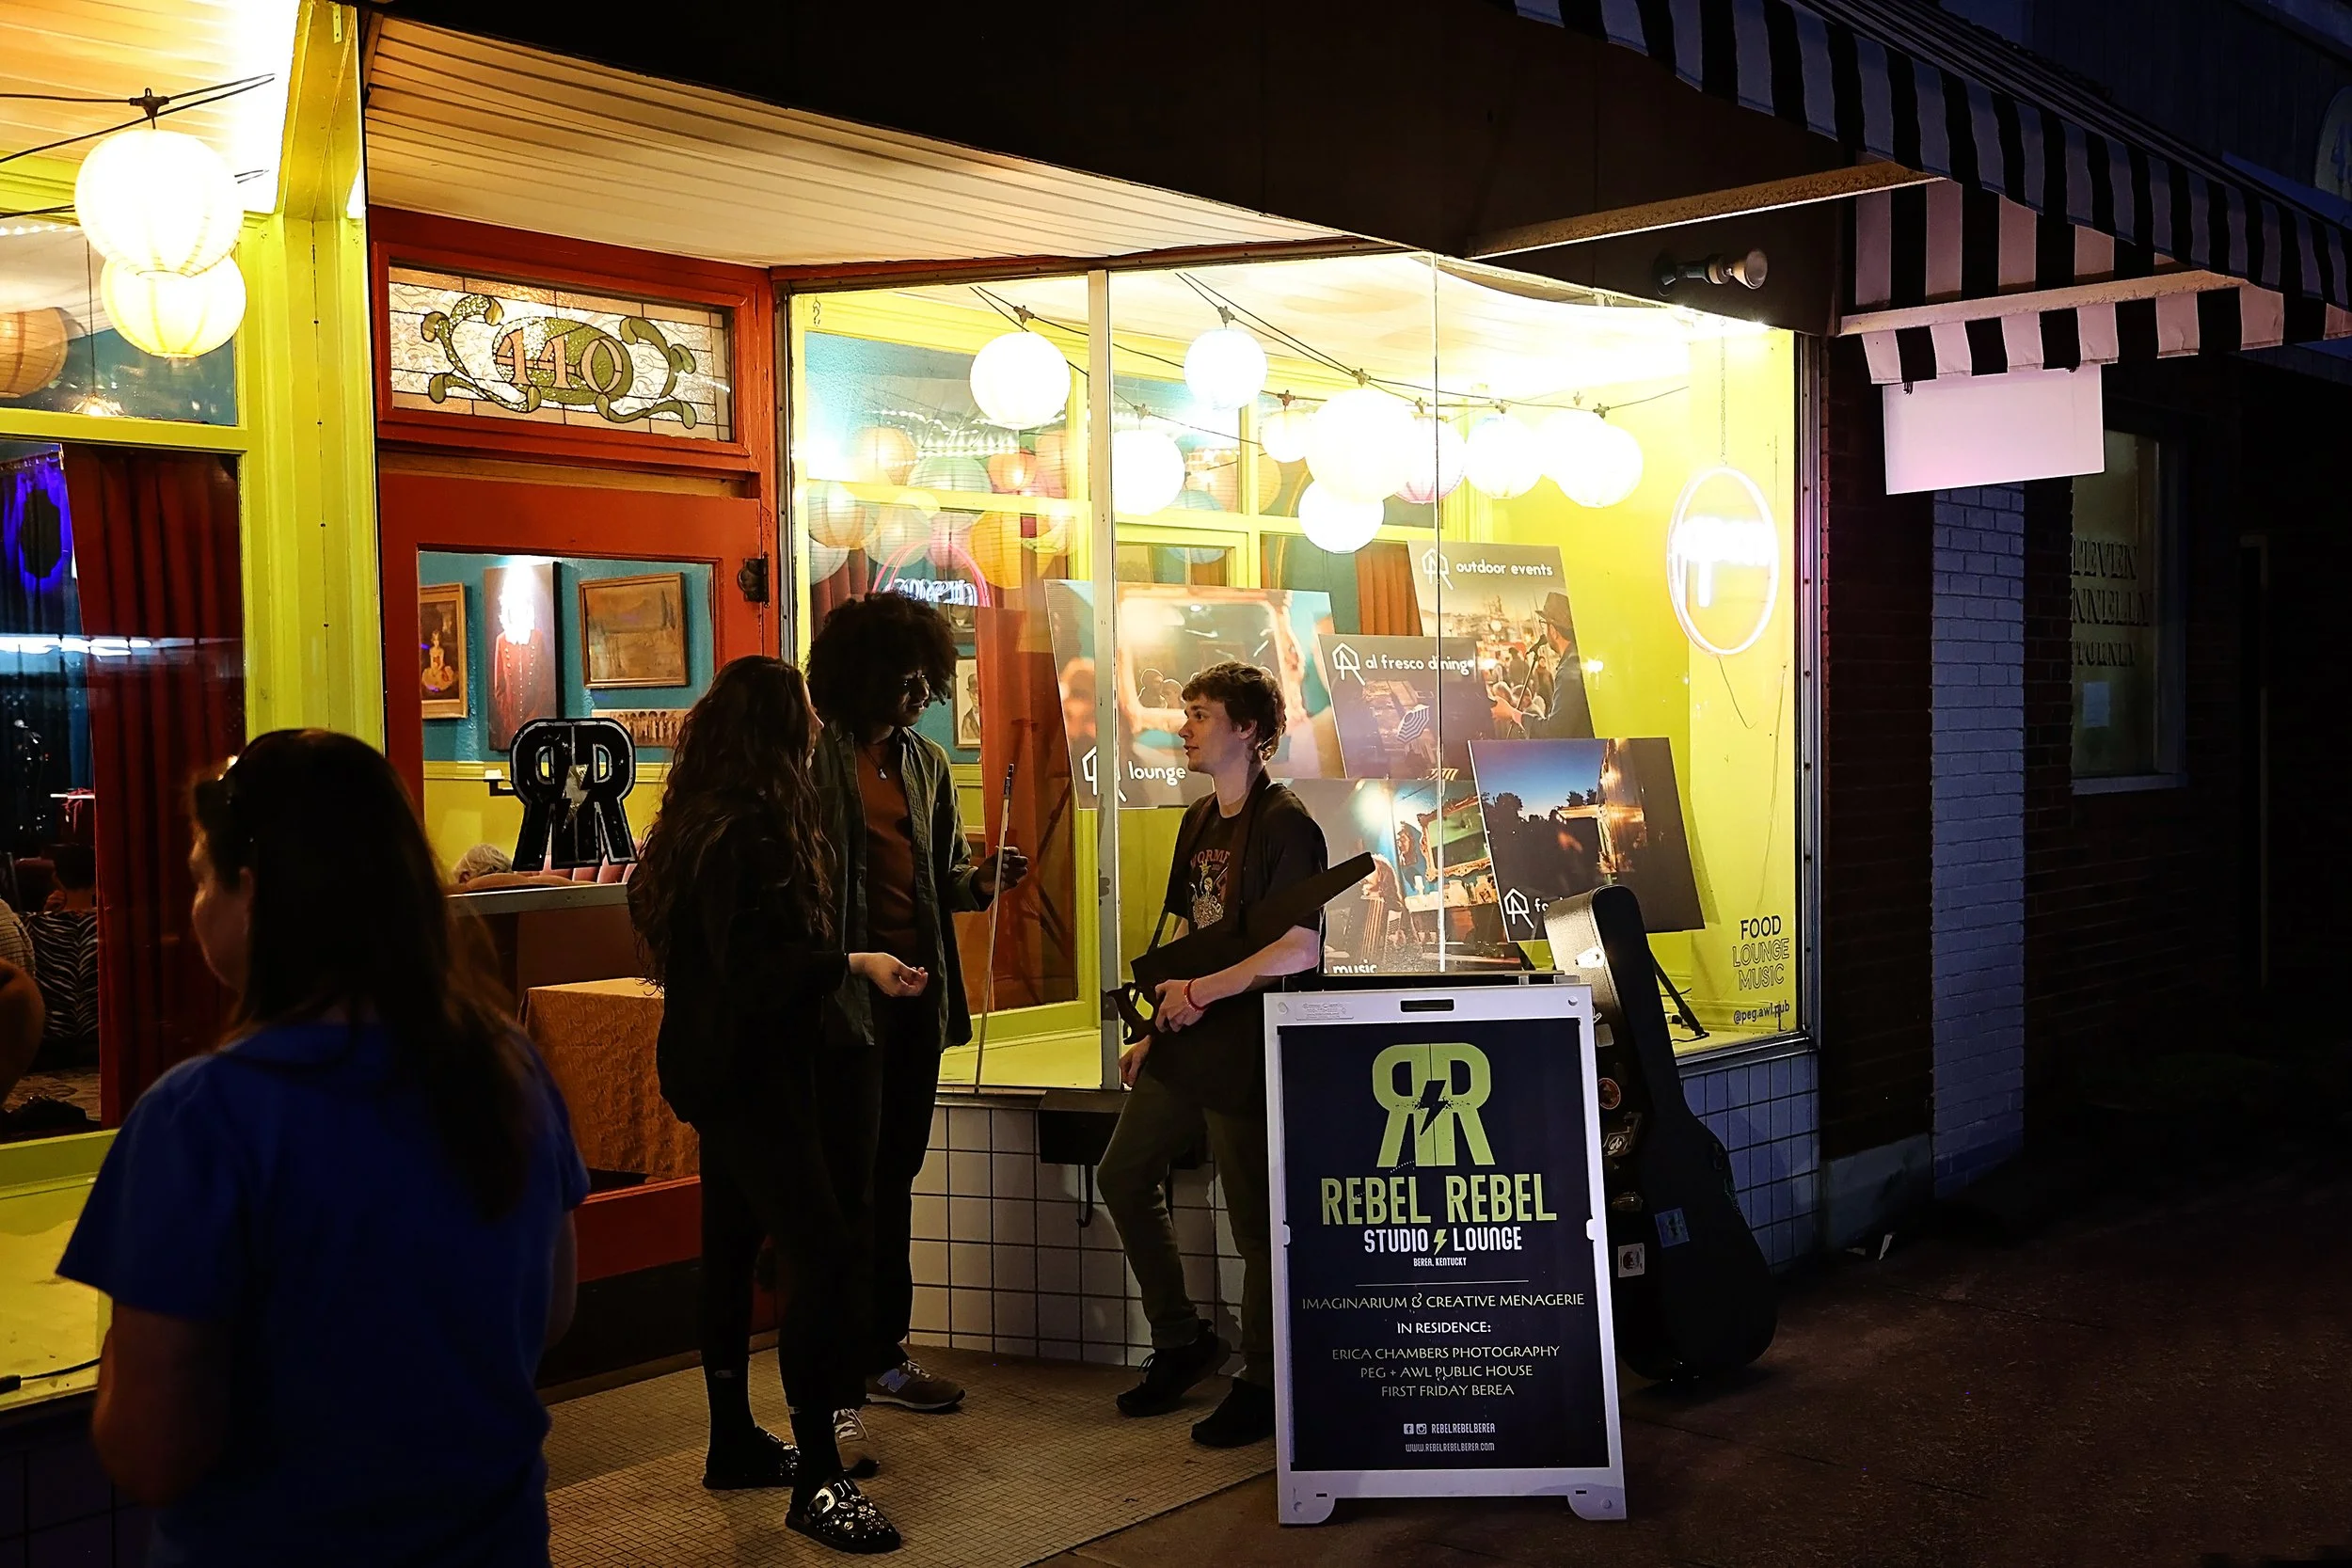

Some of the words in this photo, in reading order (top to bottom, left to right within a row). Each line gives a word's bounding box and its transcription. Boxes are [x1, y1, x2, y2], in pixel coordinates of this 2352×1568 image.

[496, 328, 623, 393] 440
[1456, 559, 1506, 575] outdoor
[1510, 563, 1553, 577] events
[1365, 654, 1377, 670] al
[1381, 654, 1424, 671] fresco
[1128, 760, 1186, 786] lounge
[1740, 915, 1782, 940] FOOD
[1732, 938, 1789, 967] LOUNGE
[1332, 958, 1377, 974] music
[1739, 963, 1785, 991] MUSIC
[1733, 1000, 1790, 1025] @peg.awl.pub
[1321, 1176, 1431, 1225] REBEL
[1446, 1173, 1557, 1223] REBEL
[1364, 1228, 1428, 1253] STUDIO
[1454, 1227, 1522, 1251] LOUNGE
[1436, 1257, 1467, 1267] KENTUCKY
[1302, 1297, 1407, 1310] IMAGINARIUM
[1426, 1294, 1496, 1308] CREATIVE
[1500, 1293, 1584, 1307] MENAGERIE
[1397, 1322, 1412, 1334] IN
[1416, 1322, 1491, 1334] RESIDENCE:
[1332, 1348, 1372, 1360] ERICA
[1375, 1347, 1449, 1359] CHAMBERS
[1453, 1345, 1560, 1358] PHOTOGRAPHY
[1360, 1367, 1386, 1379] PEG
[1400, 1367, 1432, 1378] AWL
[1435, 1366, 1483, 1378] PUBLIC
[1486, 1364, 1534, 1376] HOUSE
[1381, 1386, 1416, 1397] FIRST
[1420, 1385, 1468, 1397] FRIDAY
[1471, 1384, 1515, 1396] BEREA
[1431, 1422, 1496, 1433] REBELREBELBEREA
